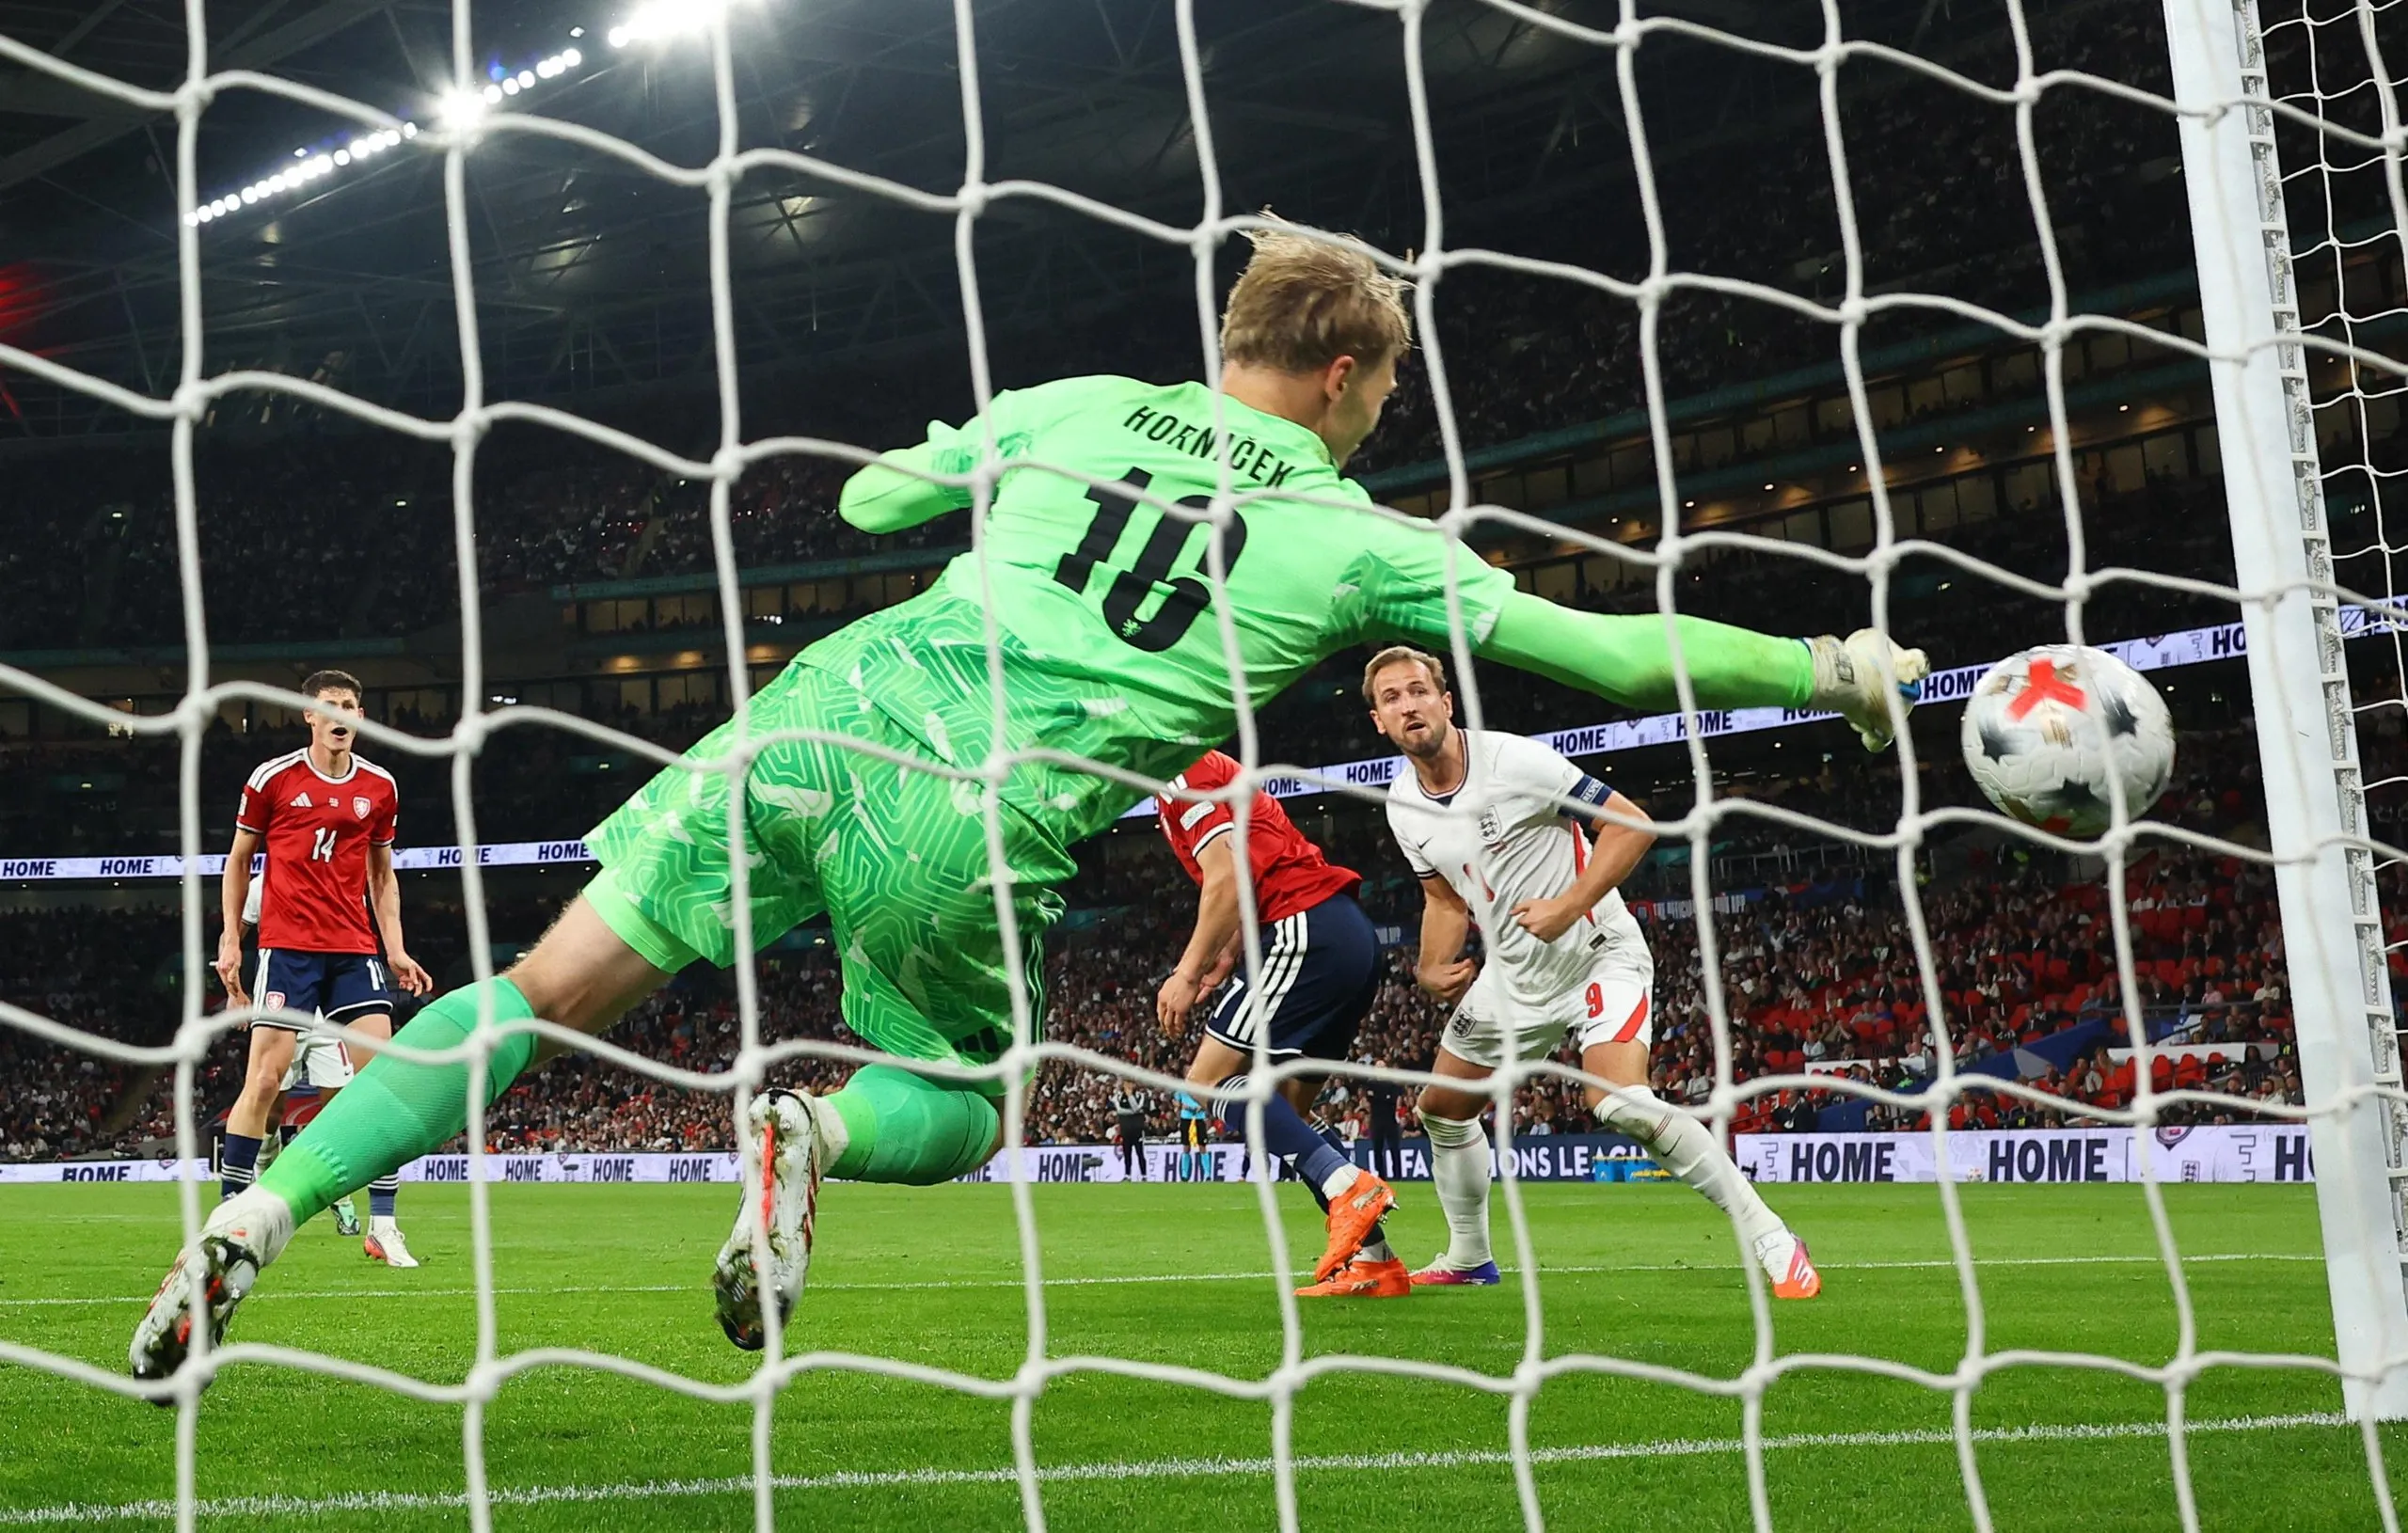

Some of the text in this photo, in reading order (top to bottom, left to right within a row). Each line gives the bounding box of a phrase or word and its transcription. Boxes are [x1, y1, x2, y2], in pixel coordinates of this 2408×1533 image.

[1553, 728, 1606, 752] HOME
[1347, 760, 1393, 783] HOME
[312, 827, 338, 863] 14
[538, 843, 589, 861] HOME
[3, 861, 56, 877] HOME
[100, 859, 153, 875] HOME
[1585, 982, 1604, 1019] 9
[425, 1160, 468, 1181] HOME
[505, 1160, 543, 1181] HOME
[593, 1159, 634, 1181] HOME
[668, 1159, 714, 1181] HOME
[1038, 1153, 1092, 1182] HOME
[1791, 1142, 1895, 1182] HOME
[1989, 1139, 2109, 1182] HOME
